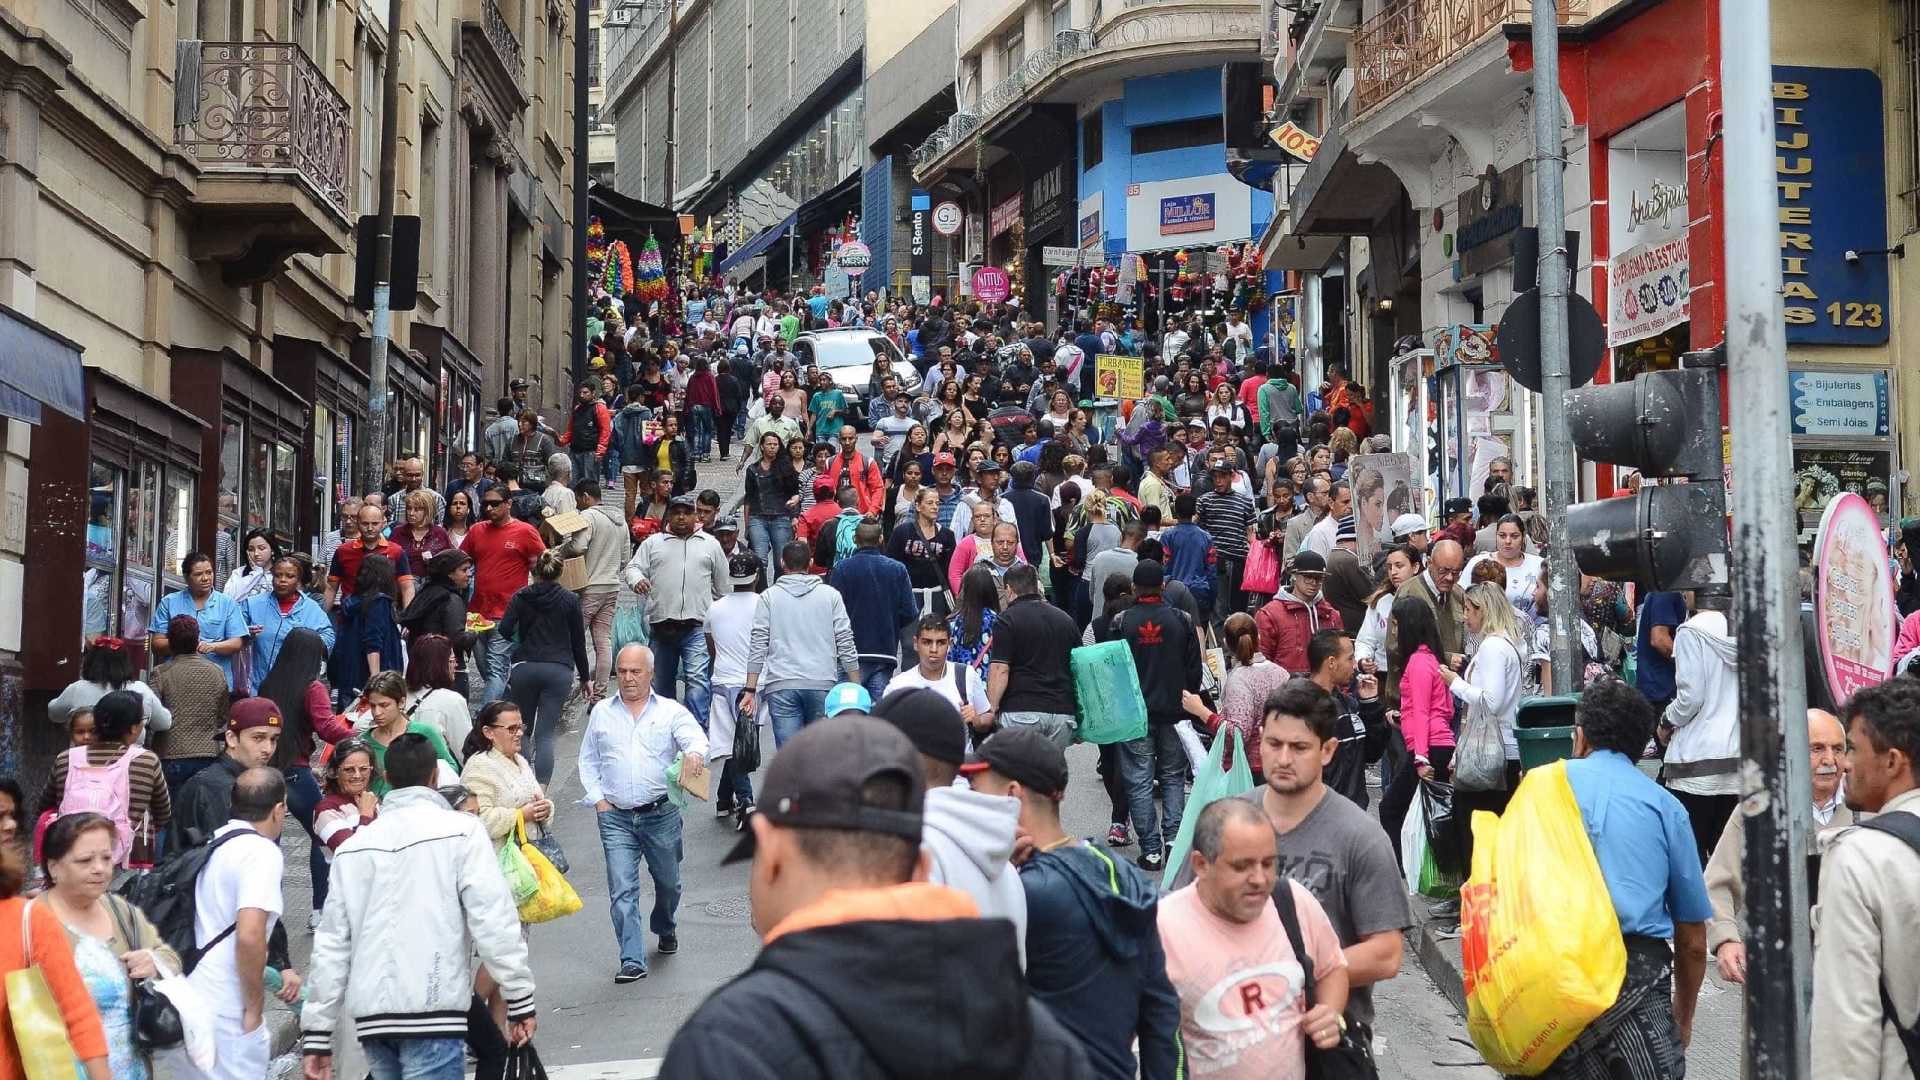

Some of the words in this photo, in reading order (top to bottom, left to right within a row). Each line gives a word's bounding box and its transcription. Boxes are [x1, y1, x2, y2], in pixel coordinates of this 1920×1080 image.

[1279, 125, 1321, 158] 103
[937, 207, 957, 222] GJ
[1773, 82, 1818, 325] BIJUTERIAS
[912, 212, 922, 256] S.Bento
[1826, 302, 1884, 328] 123
[1815, 380, 1862, 392] Bijuterias
[1816, 398, 1874, 410] Embalagens
[1817, 417, 1840, 427] Semi
[1843, 417, 1868, 427] Jóias
[1241, 981, 1265, 1015] R
